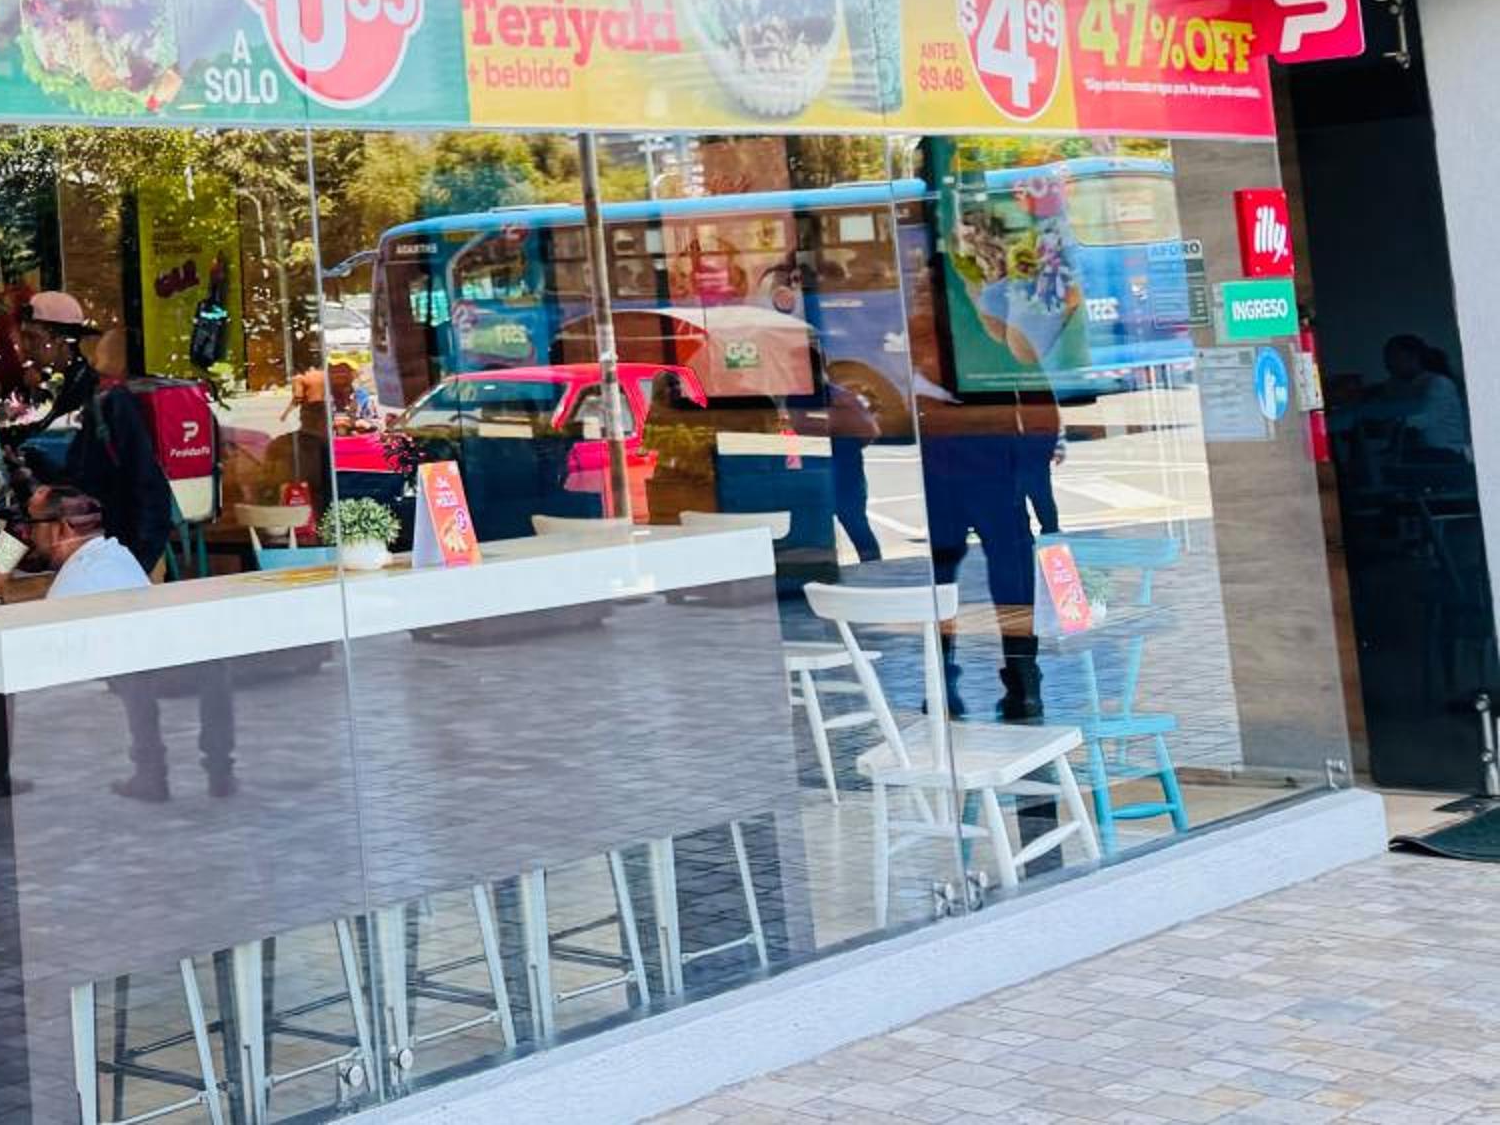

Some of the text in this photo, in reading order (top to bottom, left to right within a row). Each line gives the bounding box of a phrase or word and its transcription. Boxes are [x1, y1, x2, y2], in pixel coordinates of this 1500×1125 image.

[232, 29, 252, 65] A
[204, 67, 279, 104] SOLO
[484, 57, 571, 89] bebida
[1232, 298, 1289, 321] INGRESO
